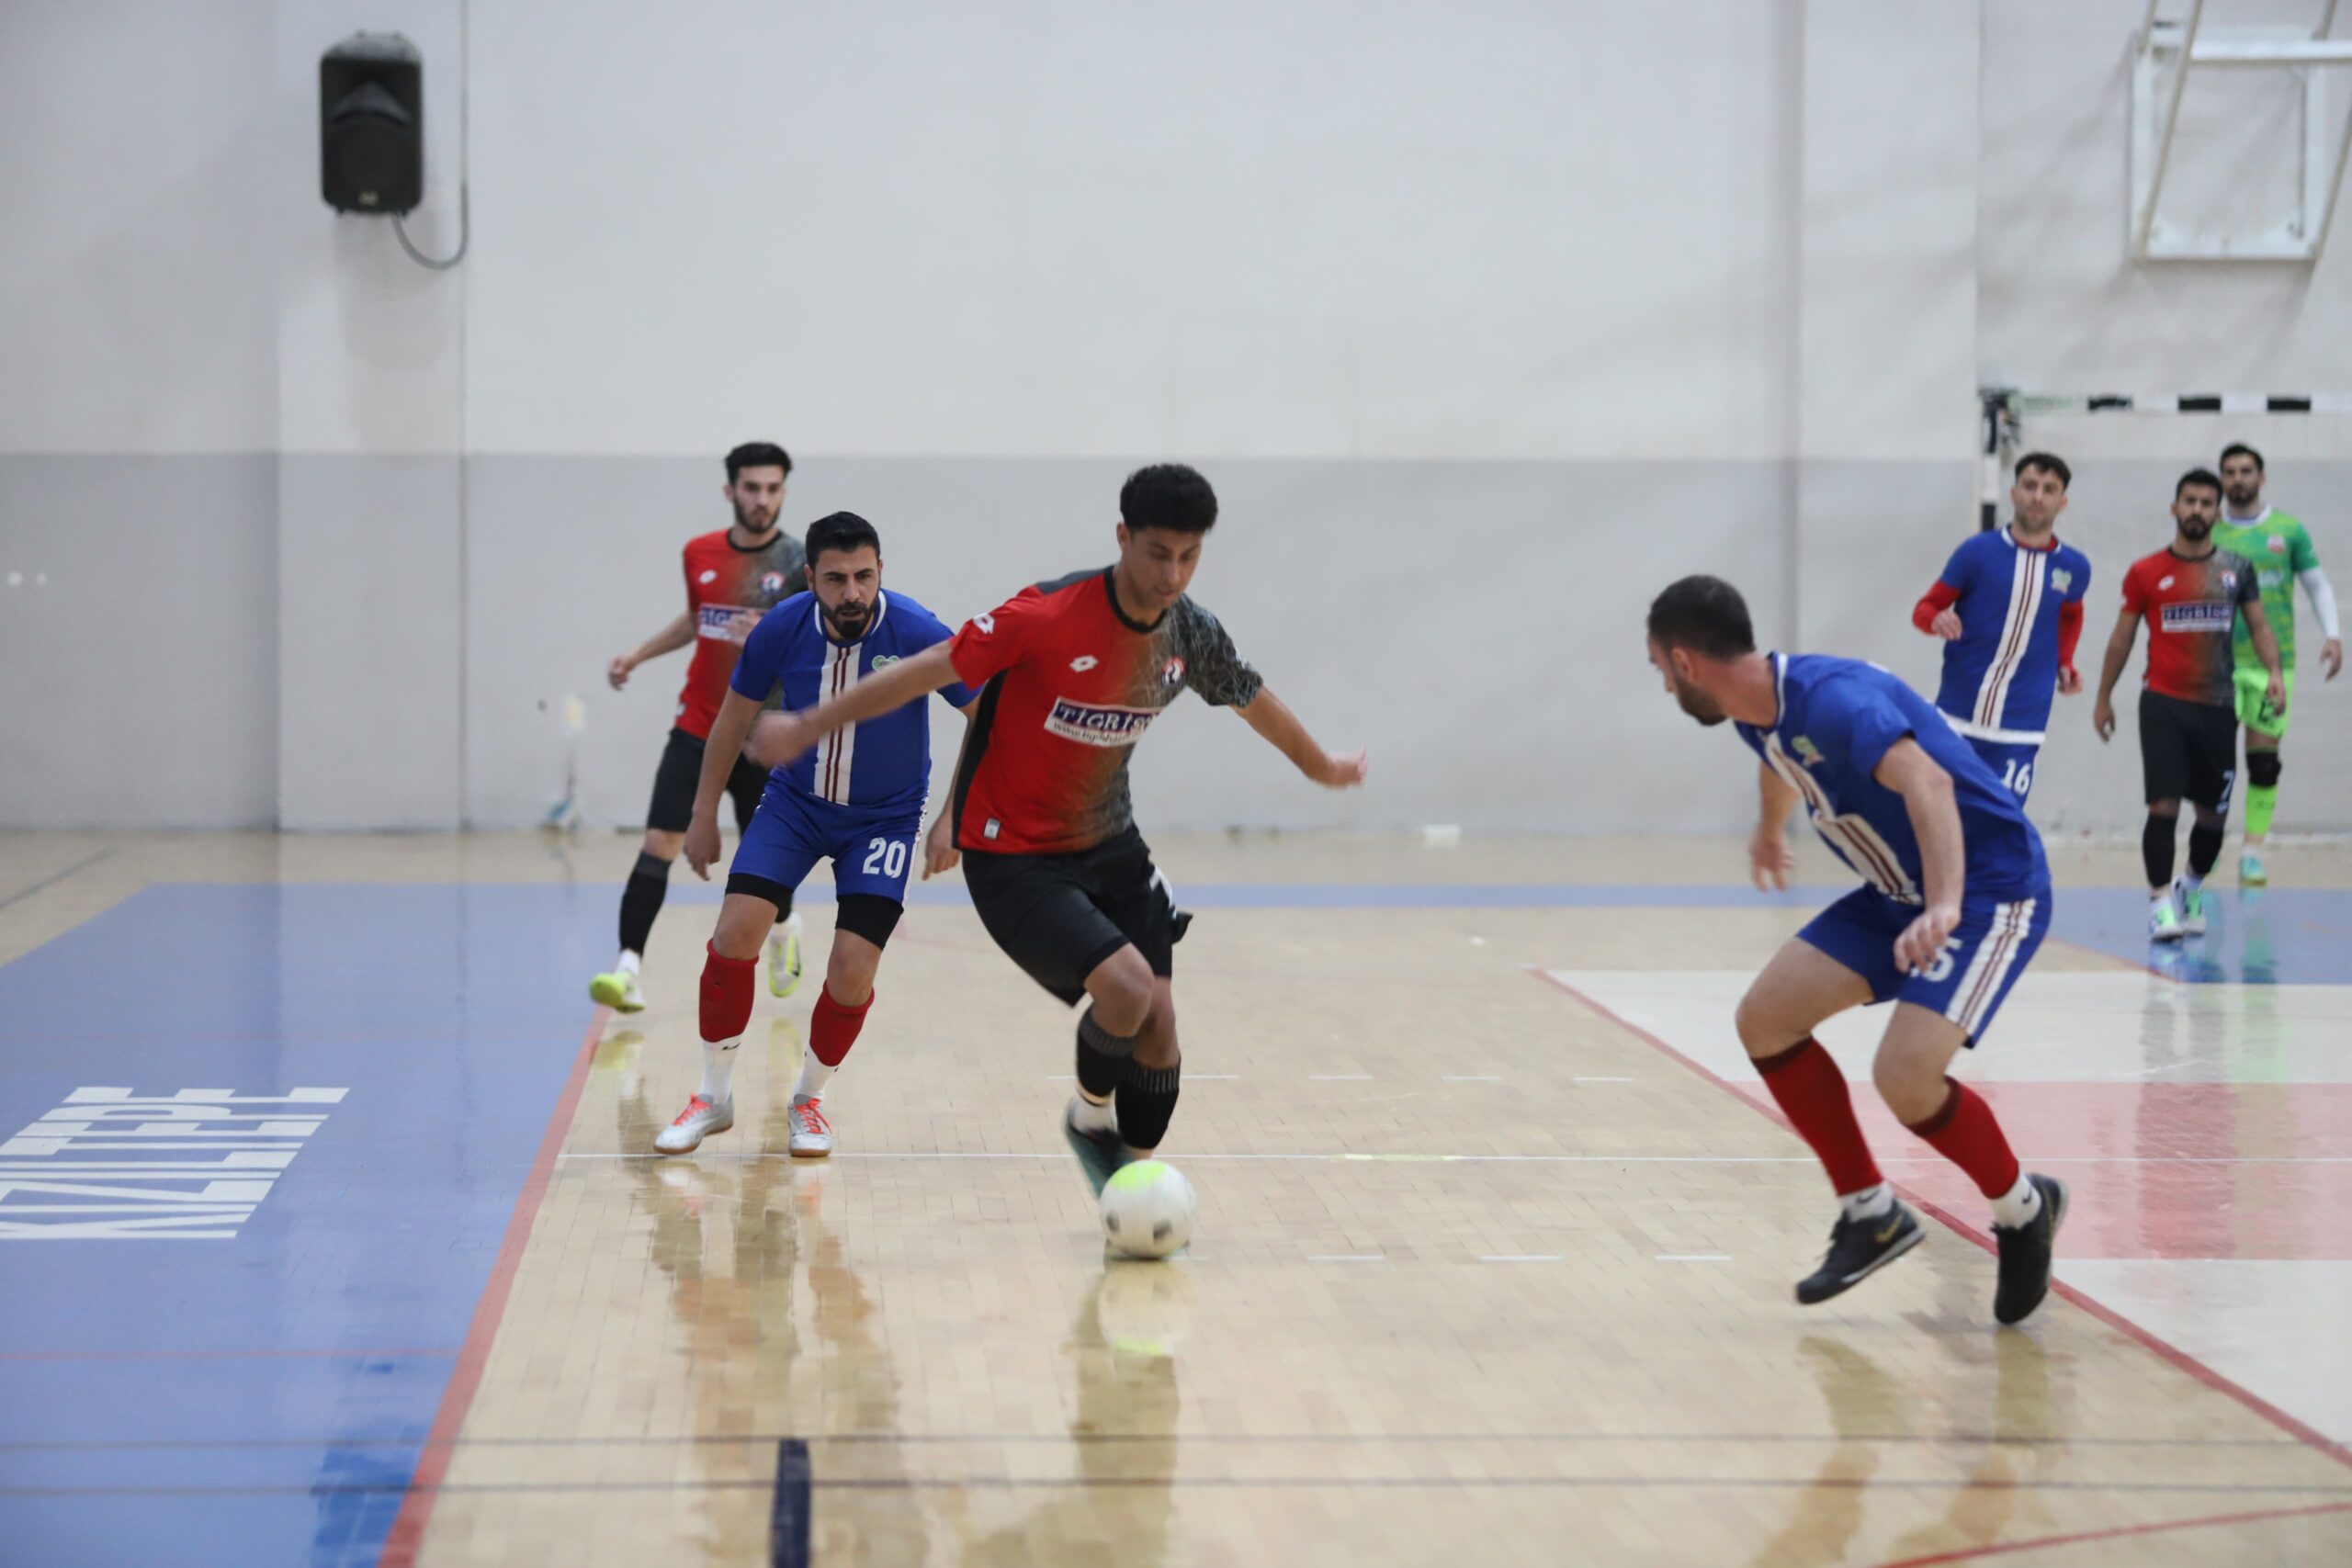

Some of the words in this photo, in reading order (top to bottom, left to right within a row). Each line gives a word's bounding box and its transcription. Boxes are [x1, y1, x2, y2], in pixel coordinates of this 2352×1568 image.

[2000, 758, 2031, 795] 16
[2222, 770, 2234, 800] 7
[862, 837, 906, 878] 20
[1910, 937, 1962, 981] 5
